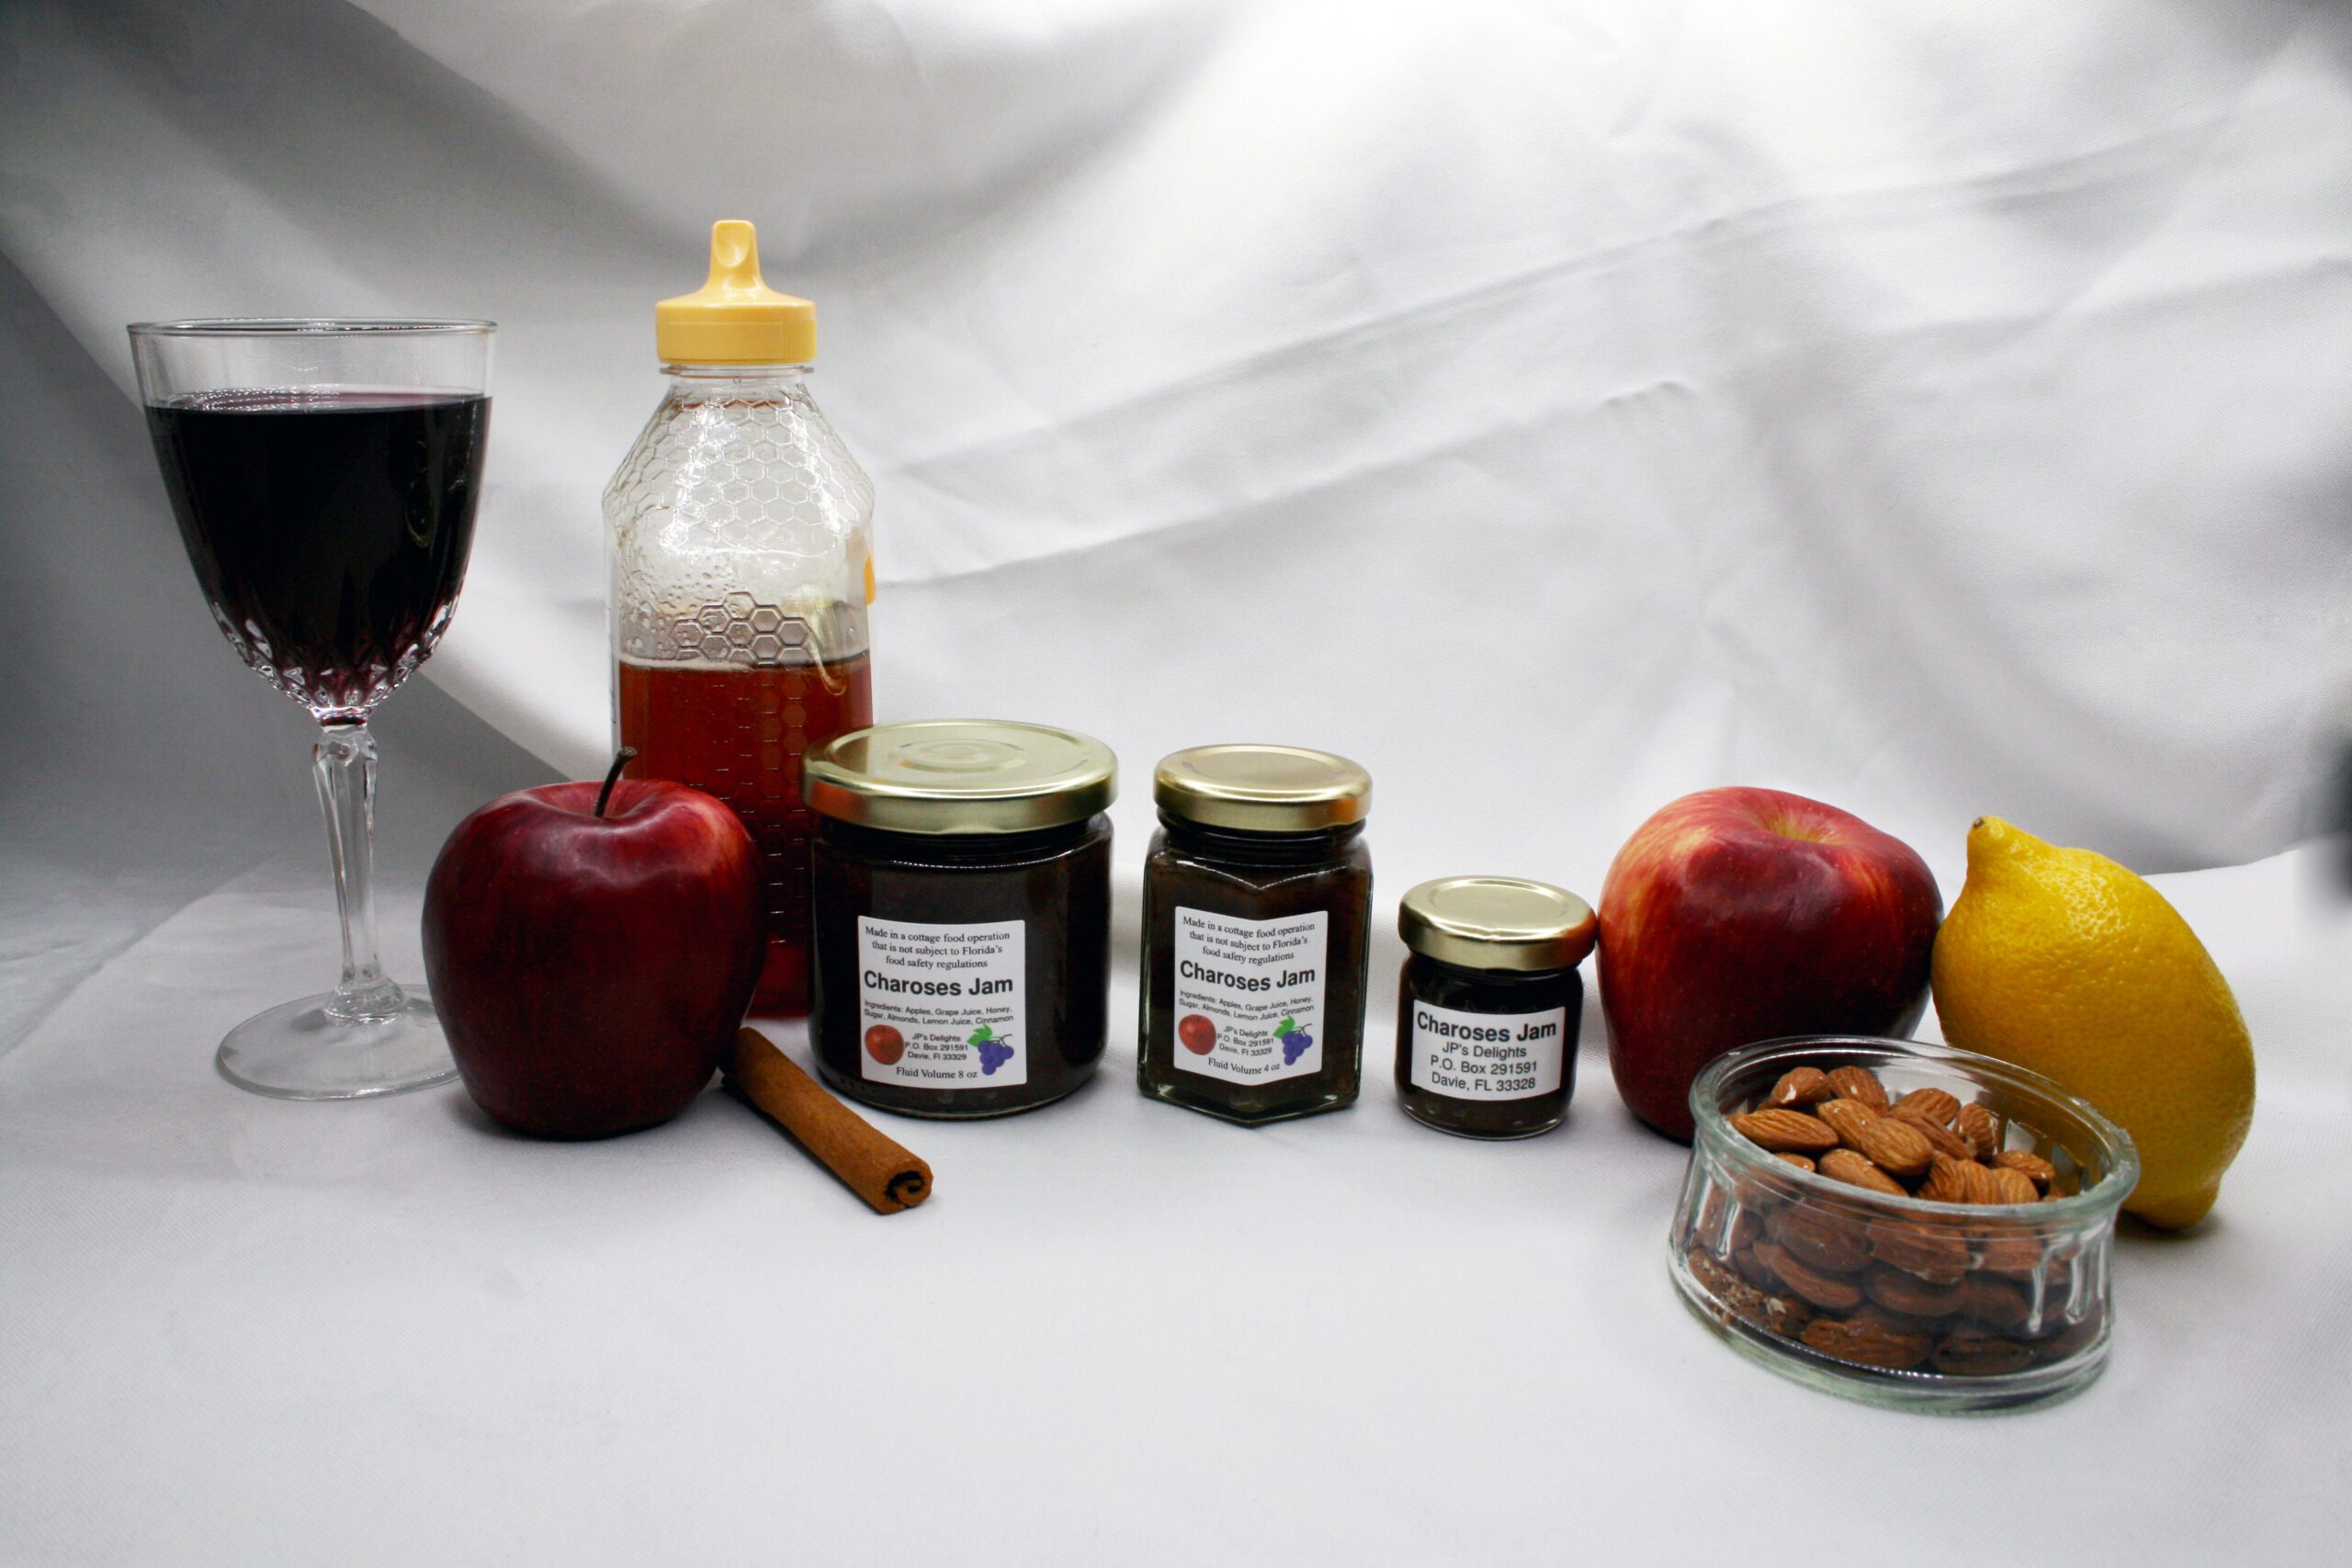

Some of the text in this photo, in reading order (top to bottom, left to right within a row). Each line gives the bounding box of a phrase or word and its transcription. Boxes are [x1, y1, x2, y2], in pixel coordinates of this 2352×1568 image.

[865, 926, 888, 938] Made
[908, 933, 940, 942] cottage
[967, 932, 1010, 943] operation
[1183, 916, 1205, 928] Made
[1208, 921, 1216, 930] in
[1225, 925, 1253, 938] cottage
[1257, 928, 1275, 938] food
[1278, 922, 1315, 936] operation
[873, 941, 887, 950] that
[890, 943, 897, 952] is
[899, 945, 912, 953] not
[915, 946, 947, 956] subject
[963, 945, 1002, 954] Florida's
[1190, 931, 1307, 951] that is not subject to Florida's
[886, 955, 988, 970] food safety regulations
[1203, 946, 1295, 965] food safety regulations
[865, 970, 1012, 996] Charoses Jam
[1180, 960, 1316, 992] Charoses Jam
[1417, 1011, 1556, 1042] Charoses Jam
[1442, 1042, 1527, 1061] JP's Delights
[896, 1066, 919, 1077] Fluid
[921, 1069, 955, 1078] Volume
[958, 1070, 964, 1078] 8
[1208, 1057, 1228, 1070] Fluid
[1230, 1063, 1261, 1075] Volume
[1264, 1064, 1269, 1072] 4
[1430, 1055, 1537, 1075] P.O. Box 291591
[1431, 1072, 1535, 1091] Davie, FL 33328
